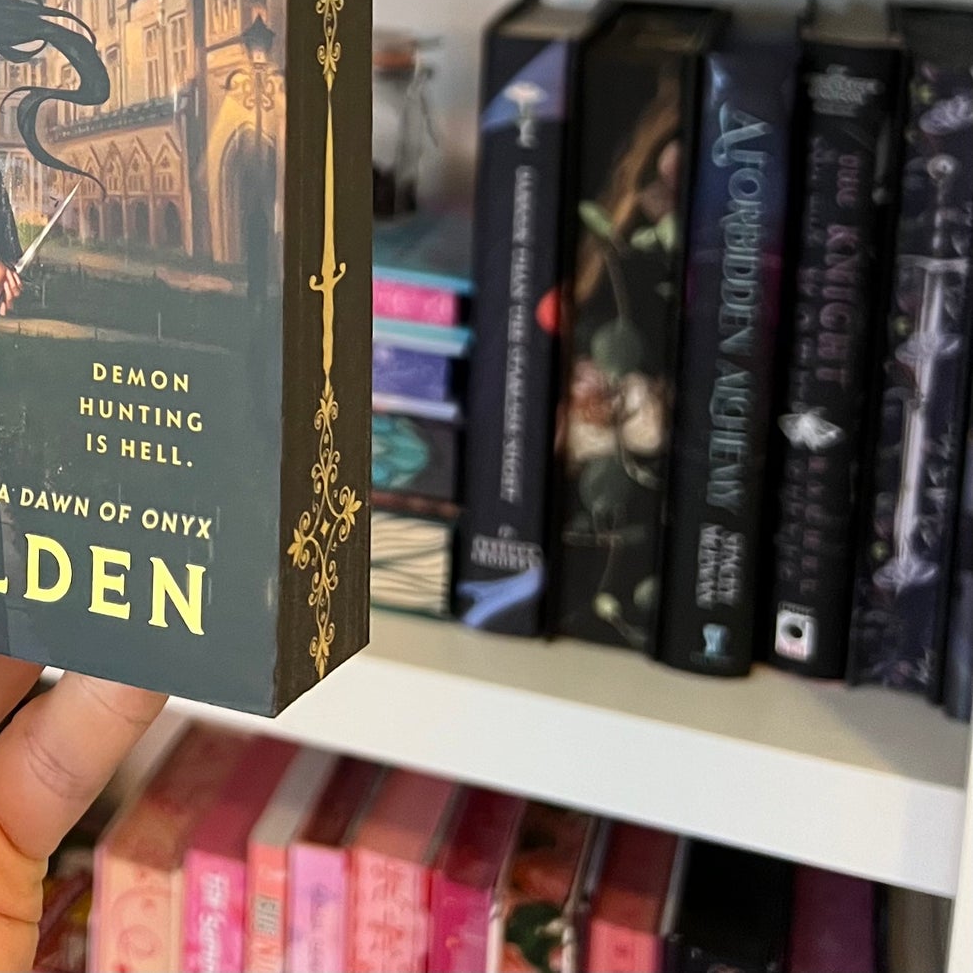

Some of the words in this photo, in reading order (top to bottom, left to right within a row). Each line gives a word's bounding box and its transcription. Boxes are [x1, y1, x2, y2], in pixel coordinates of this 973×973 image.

[92, 362, 190, 393] DEMON
[79, 396, 203, 432] HUNTING
[86, 432, 108, 454] IS
[120, 438, 194, 468] HELL.
[19, 487, 90, 517] DAWN
[99, 501, 132, 524] OF
[141, 508, 212, 540] ONYX
